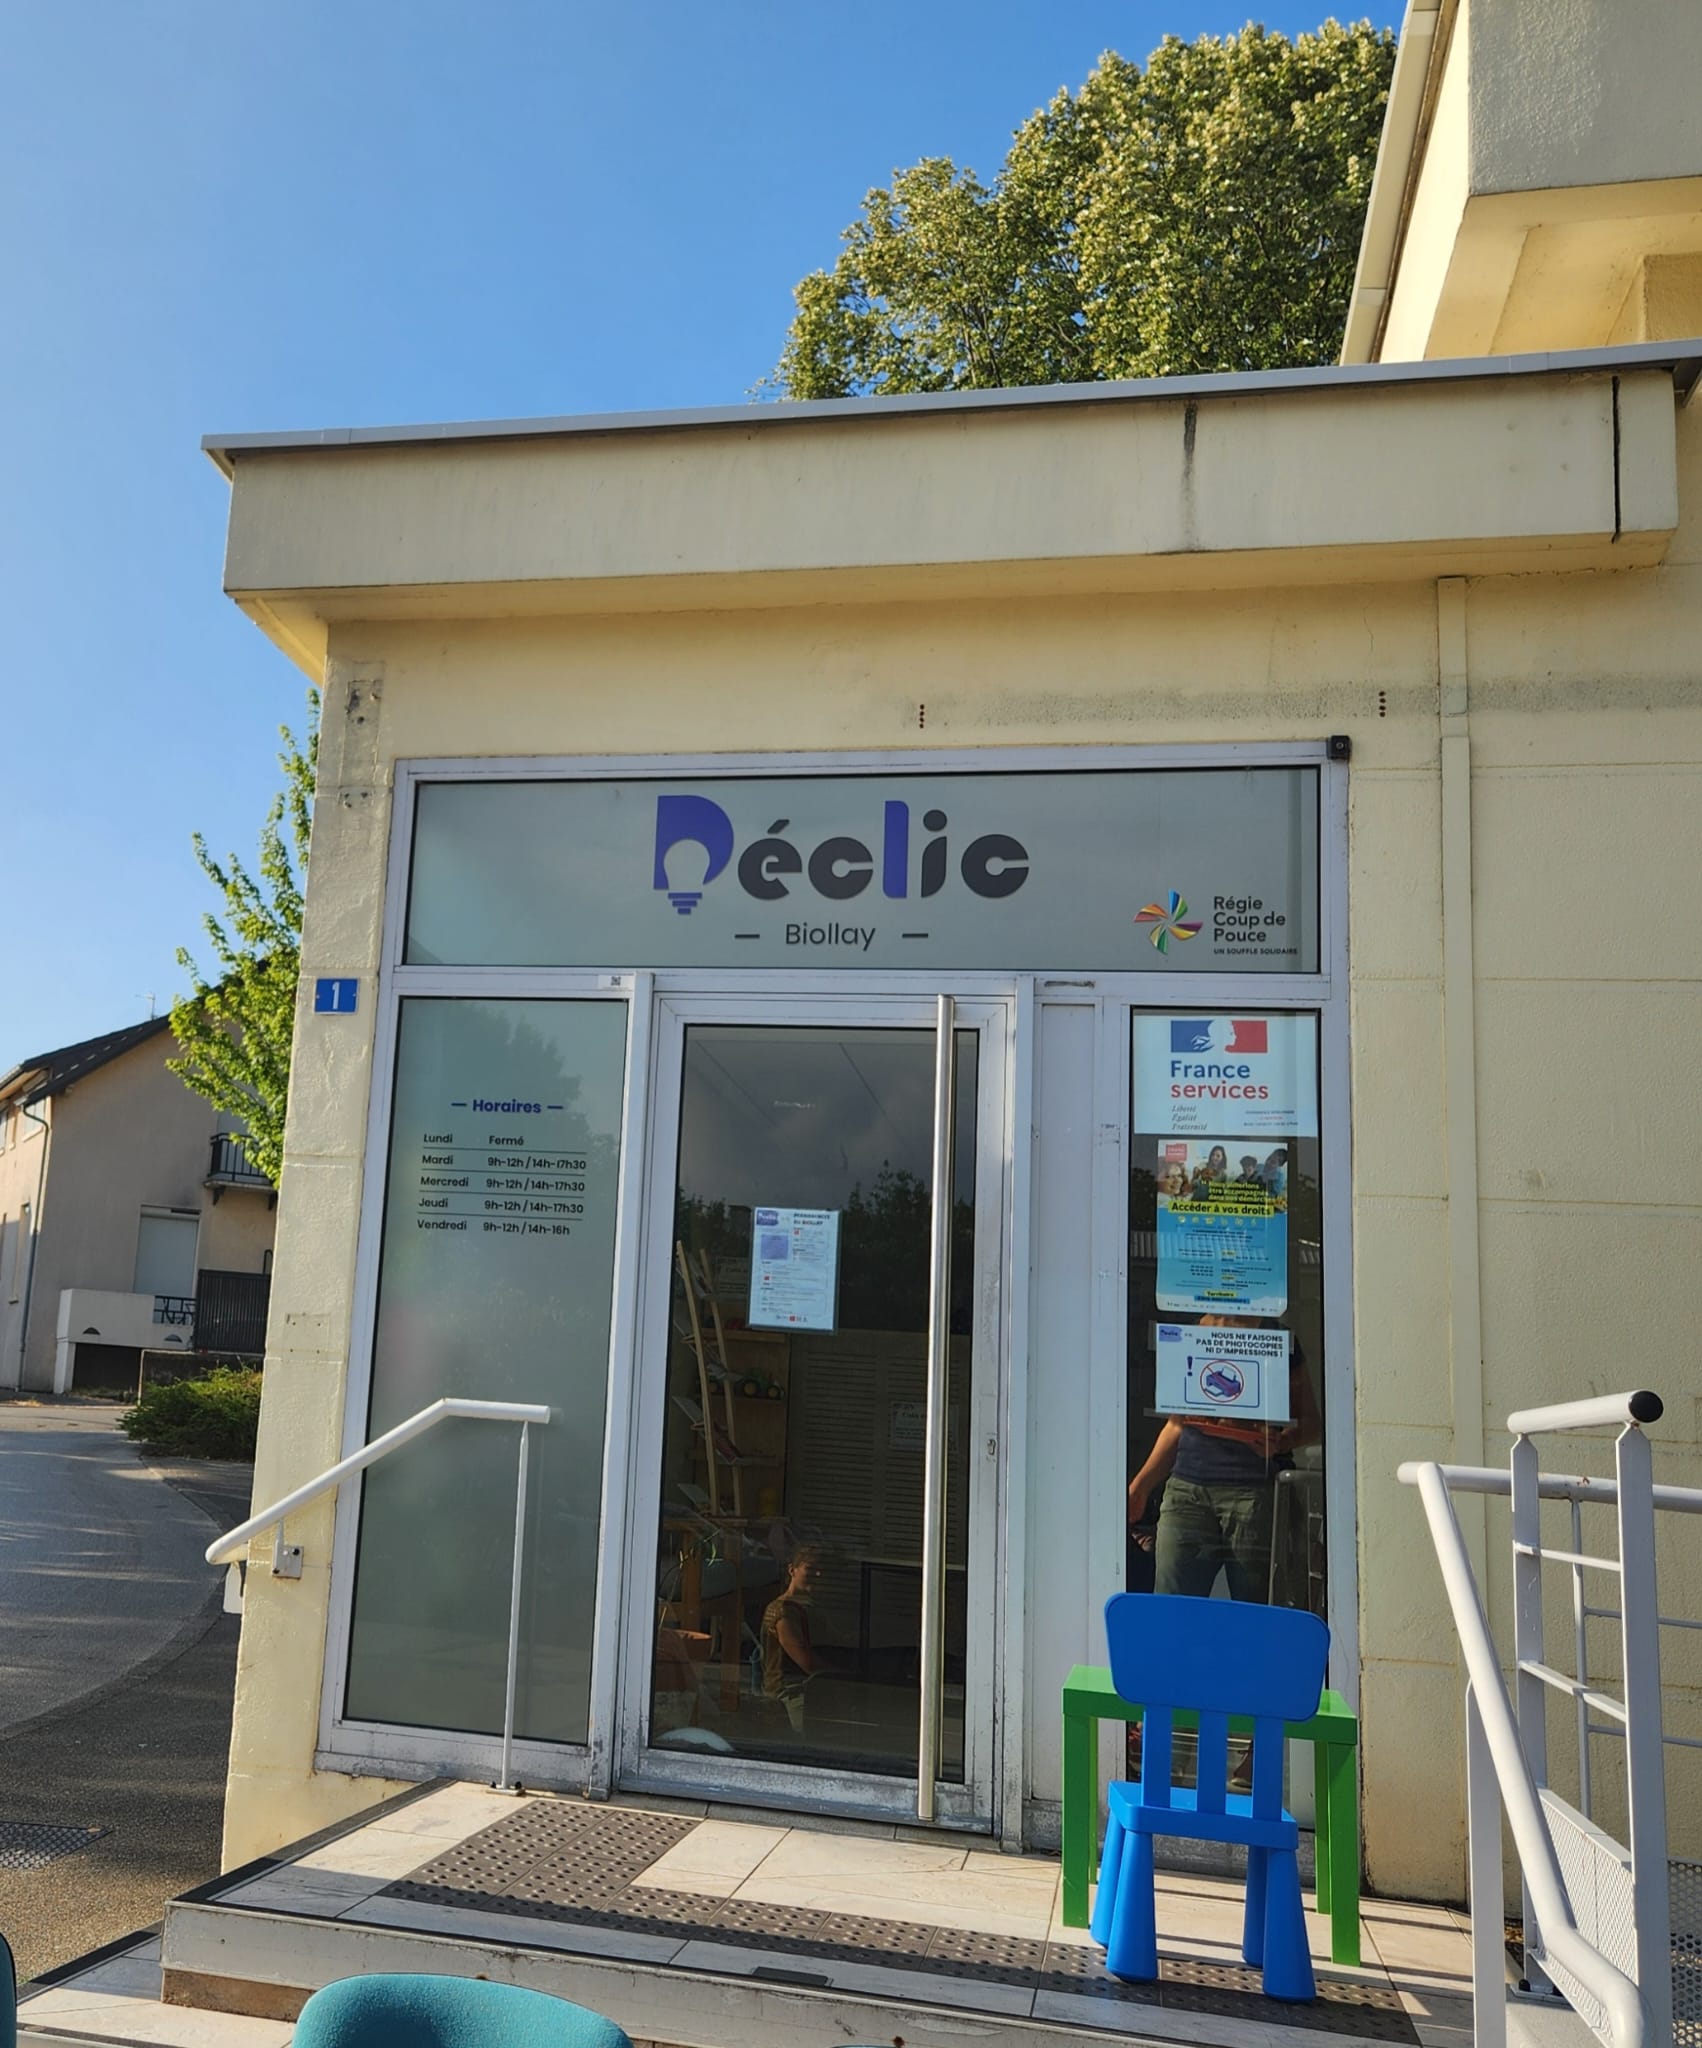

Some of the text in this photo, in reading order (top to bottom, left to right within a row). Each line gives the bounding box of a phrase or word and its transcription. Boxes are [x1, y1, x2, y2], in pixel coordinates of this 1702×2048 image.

[653, 795, 1030, 914] Déclic
[1213, 896, 1263, 913] Régie
[1213, 911, 1286, 929] Coup de
[785, 923, 876, 951] Biollay
[1213, 928, 1267, 942] Pouce
[1213, 947, 1298, 955] UN SOUFFLE SOLIDAIRE
[332, 981, 340, 1010] 1
[1170, 1060, 1251, 1079] France
[1170, 1080, 1269, 1100] services
[472, 1098, 542, 1114] Horaires
[423, 1133, 524, 1146] Lundi Fermé
[421, 1155, 454, 1165] Mardi
[487, 1156, 525, 1168] 9h-12h
[532, 1158, 587, 1170] 14h-17h30
[420, 1176, 470, 1188] Mercredi
[486, 1178, 523, 1190] 9h-12h
[531, 1180, 586, 1192] 14h-17h30
[418, 1197, 449, 1209] Jeudi
[484, 1199, 521, 1212] 9h-12h
[529, 1202, 585, 1214] 14h-17h30
[1171, 1201, 1271, 1216] Accéder à vos droits
[416, 1219, 468, 1231] Vendredi
[483, 1221, 520, 1234] 9h-12h
[528, 1223, 570, 1236] 14h-16h
[1196, 1338, 1212, 1346] PAS
[1226, 1341, 1283, 1350] PHOTOCOPIES
[1211, 1332, 1234, 1340] NOUS
[1247, 1334, 1283, 1343] FAISONS
[1216, 1347, 1278, 1358] D'IMPRESSIONS
